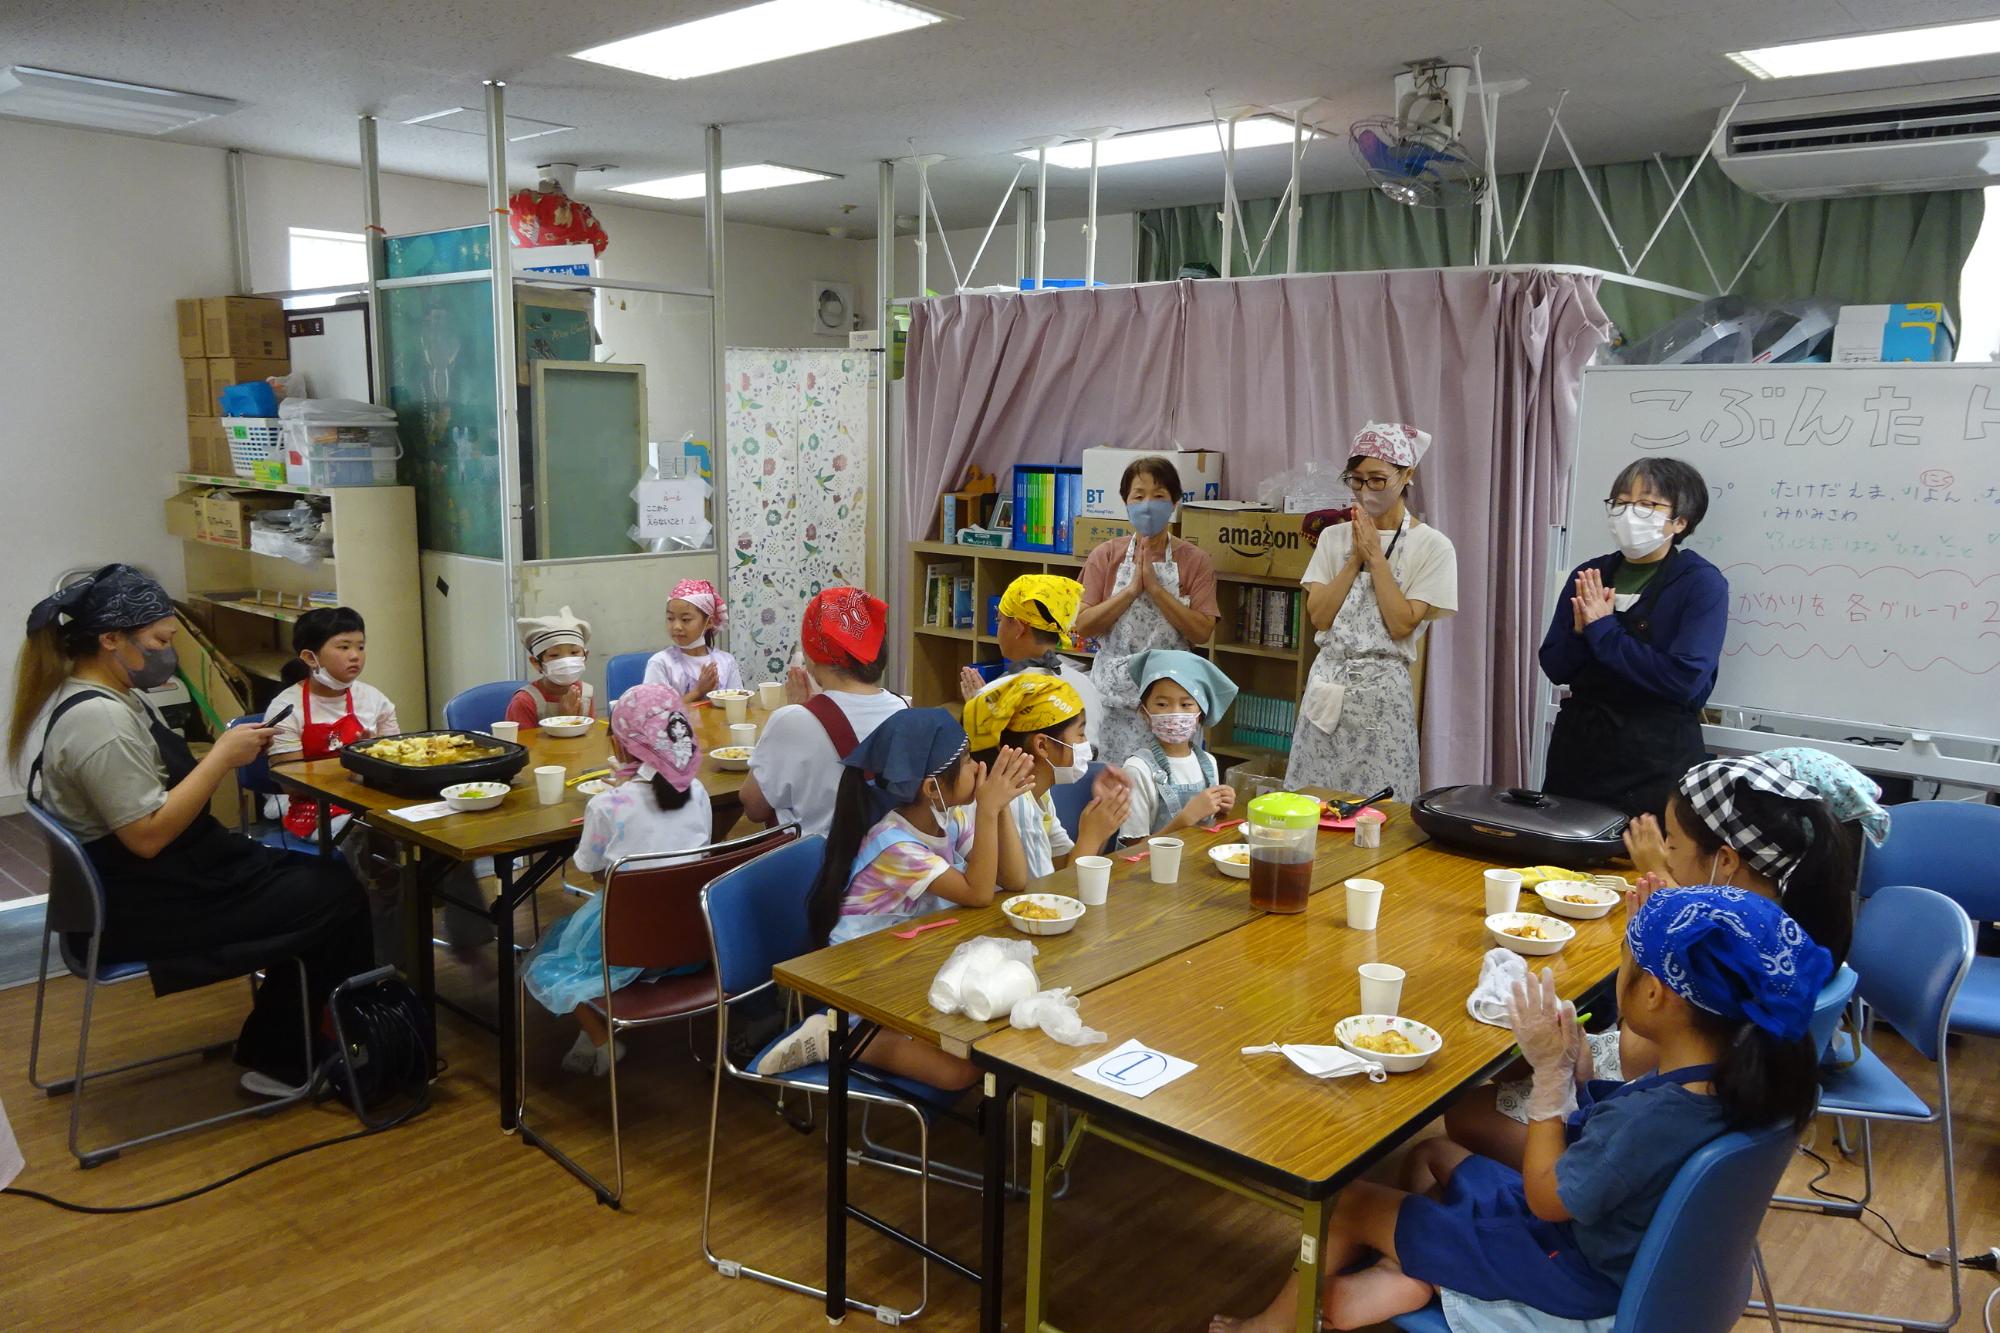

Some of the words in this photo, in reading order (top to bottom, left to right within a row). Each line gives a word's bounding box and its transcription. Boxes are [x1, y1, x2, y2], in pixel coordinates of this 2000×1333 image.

[1629, 384, 1924, 449] こぶんた
[1086, 488, 1105, 504] BT
[1218, 526, 1299, 549] amazon
[1047, 694, 1073, 714] POOH
